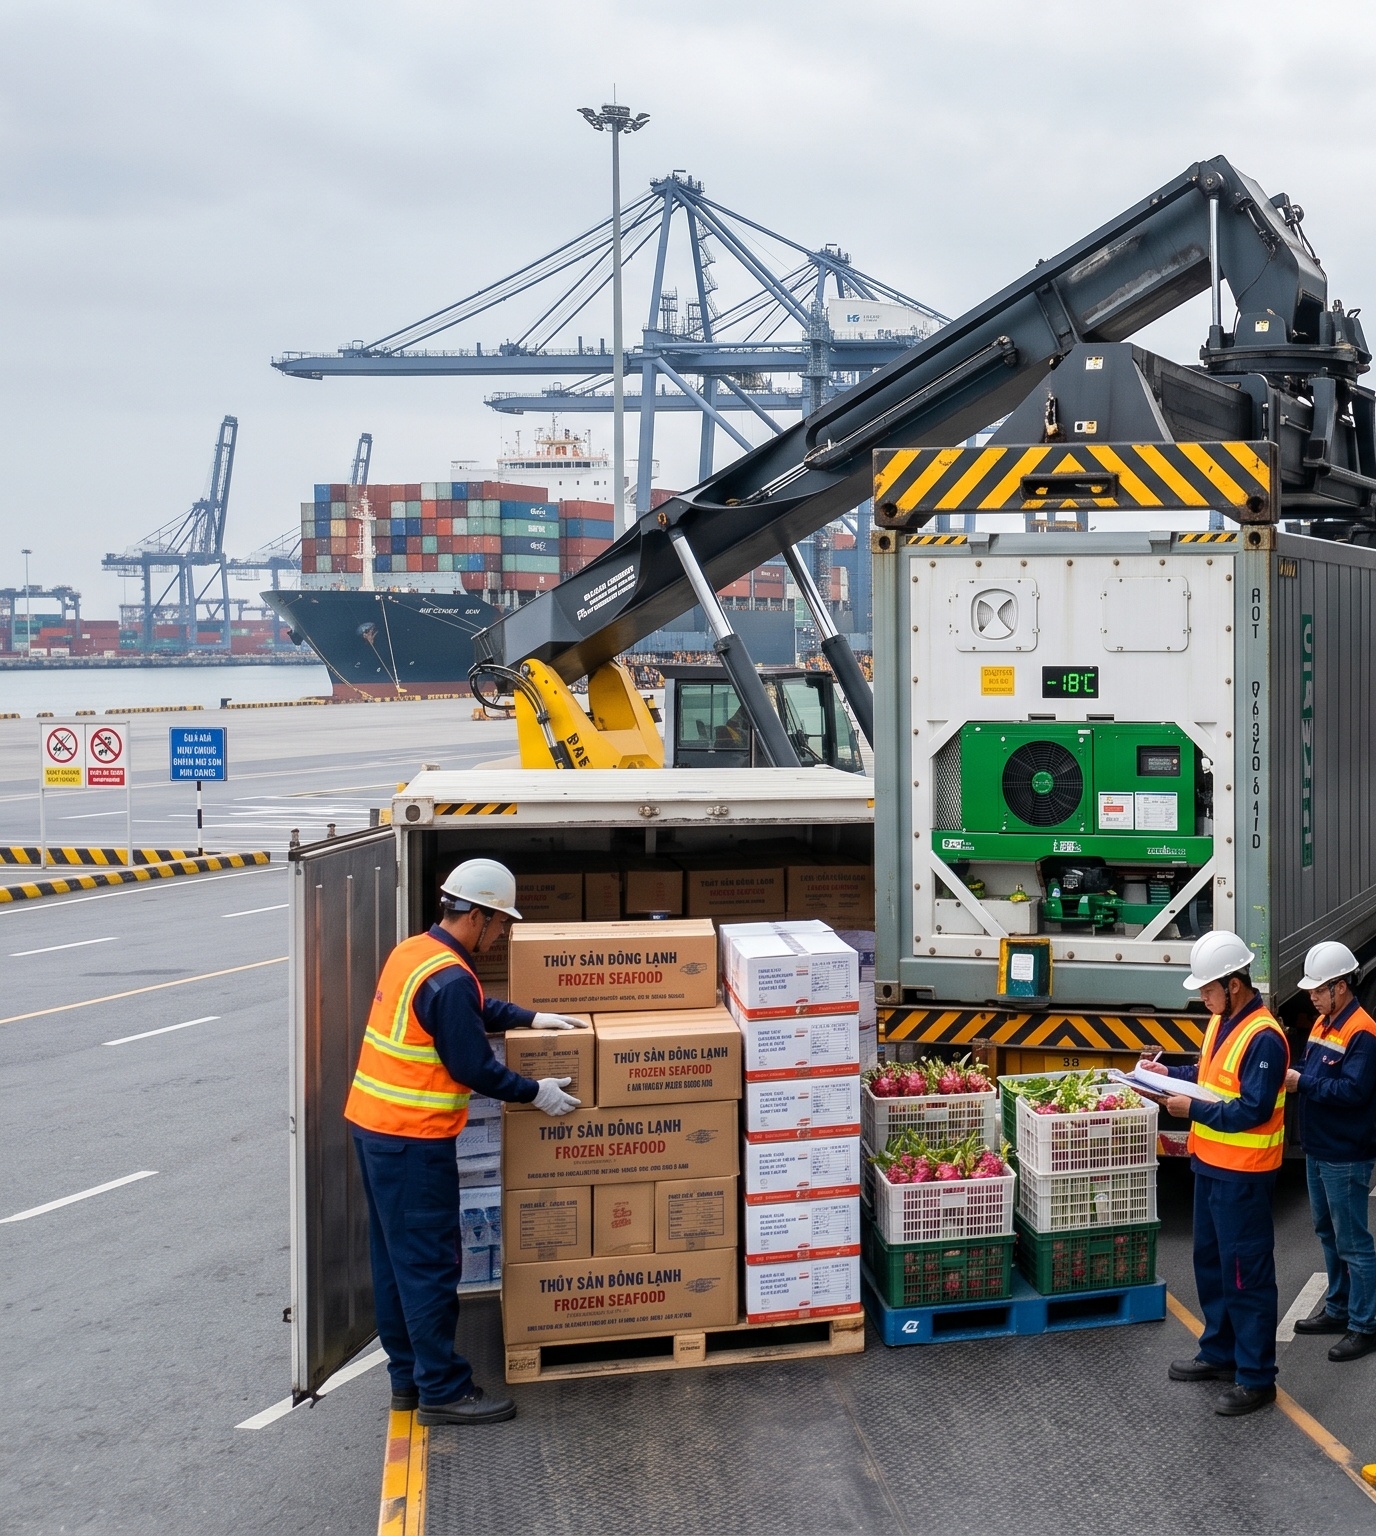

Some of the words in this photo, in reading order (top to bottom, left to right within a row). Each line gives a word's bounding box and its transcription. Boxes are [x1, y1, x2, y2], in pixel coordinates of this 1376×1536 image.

[646, 951, 677, 968] LẠNH
[558, 972, 605, 987] FROZEN
[608, 970, 663, 985] SEAFOOD
[629, 1066, 666, 1079] FROZEN
[668, 1063, 712, 1077] SEAFOOD
[648, 1119, 681, 1136] LẠNH
[555, 1143, 605, 1160] FROZEN
[608, 1140, 666, 1157] SEAFOOD
[647, 1269, 682, 1287] LẠNH
[554, 1294, 605, 1312] FROZEN
[608, 1290, 666, 1307] SEAFOOD
